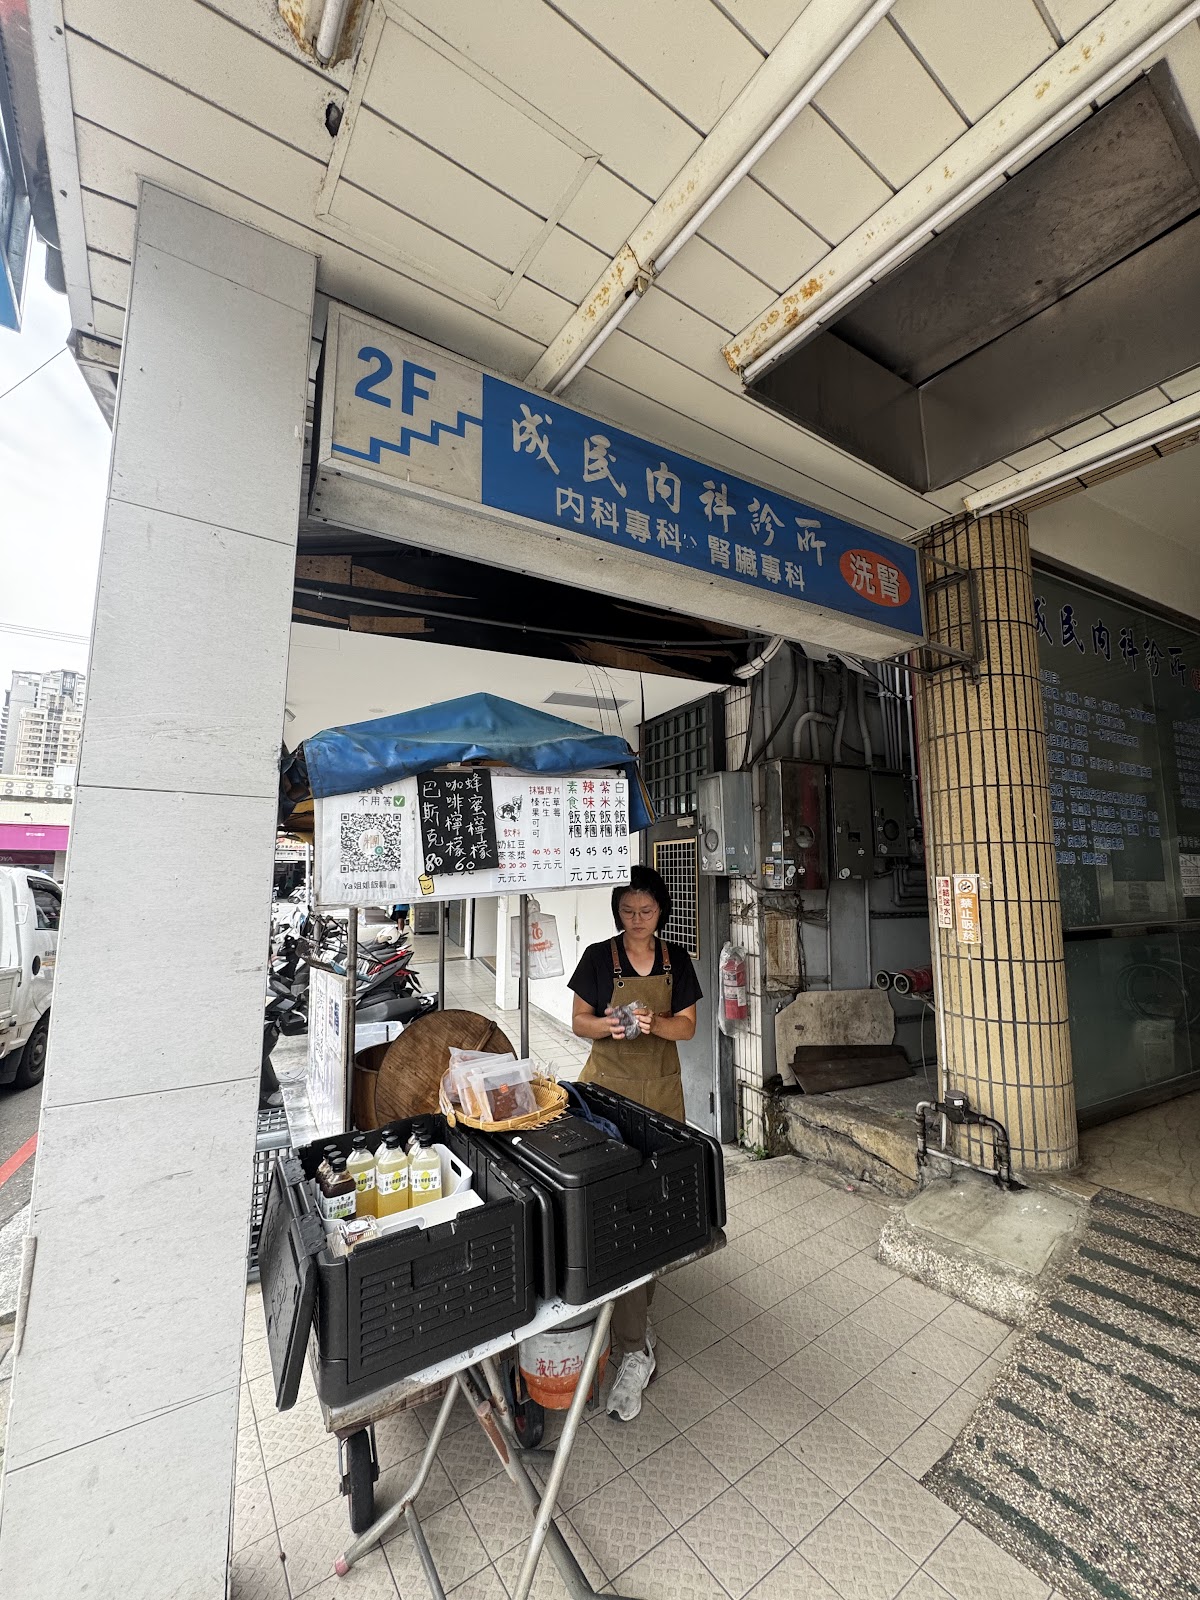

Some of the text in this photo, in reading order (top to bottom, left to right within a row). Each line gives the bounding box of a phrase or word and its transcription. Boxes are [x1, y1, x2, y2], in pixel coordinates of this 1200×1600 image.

[354, 346, 436, 416] 2F
[850, 551, 900, 604] 洗腎
[358, 796, 392, 806] 不用等
[422, 780, 444, 872] 巴斯克 80
[445, 780, 467, 857] 咖啡檸檬
[465, 773, 492, 860] 蜂蜜檸檬
[566, 781, 583, 882] 素食飯糰 45 元
[582, 780, 598, 881] 辣味飯糰 45 元
[599, 780, 614, 880] 紫米飯糰 45 元
[614, 781, 629, 879] 白米飯糰 45 元
[455, 856, 475, 871] 60
[497, 873, 507, 883] 元
[507, 873, 517, 883] 元
[517, 872, 527, 882] 元
[532, 860, 541, 870] 元
[543, 860, 552, 870] 元
[554, 859, 563, 869] 元
